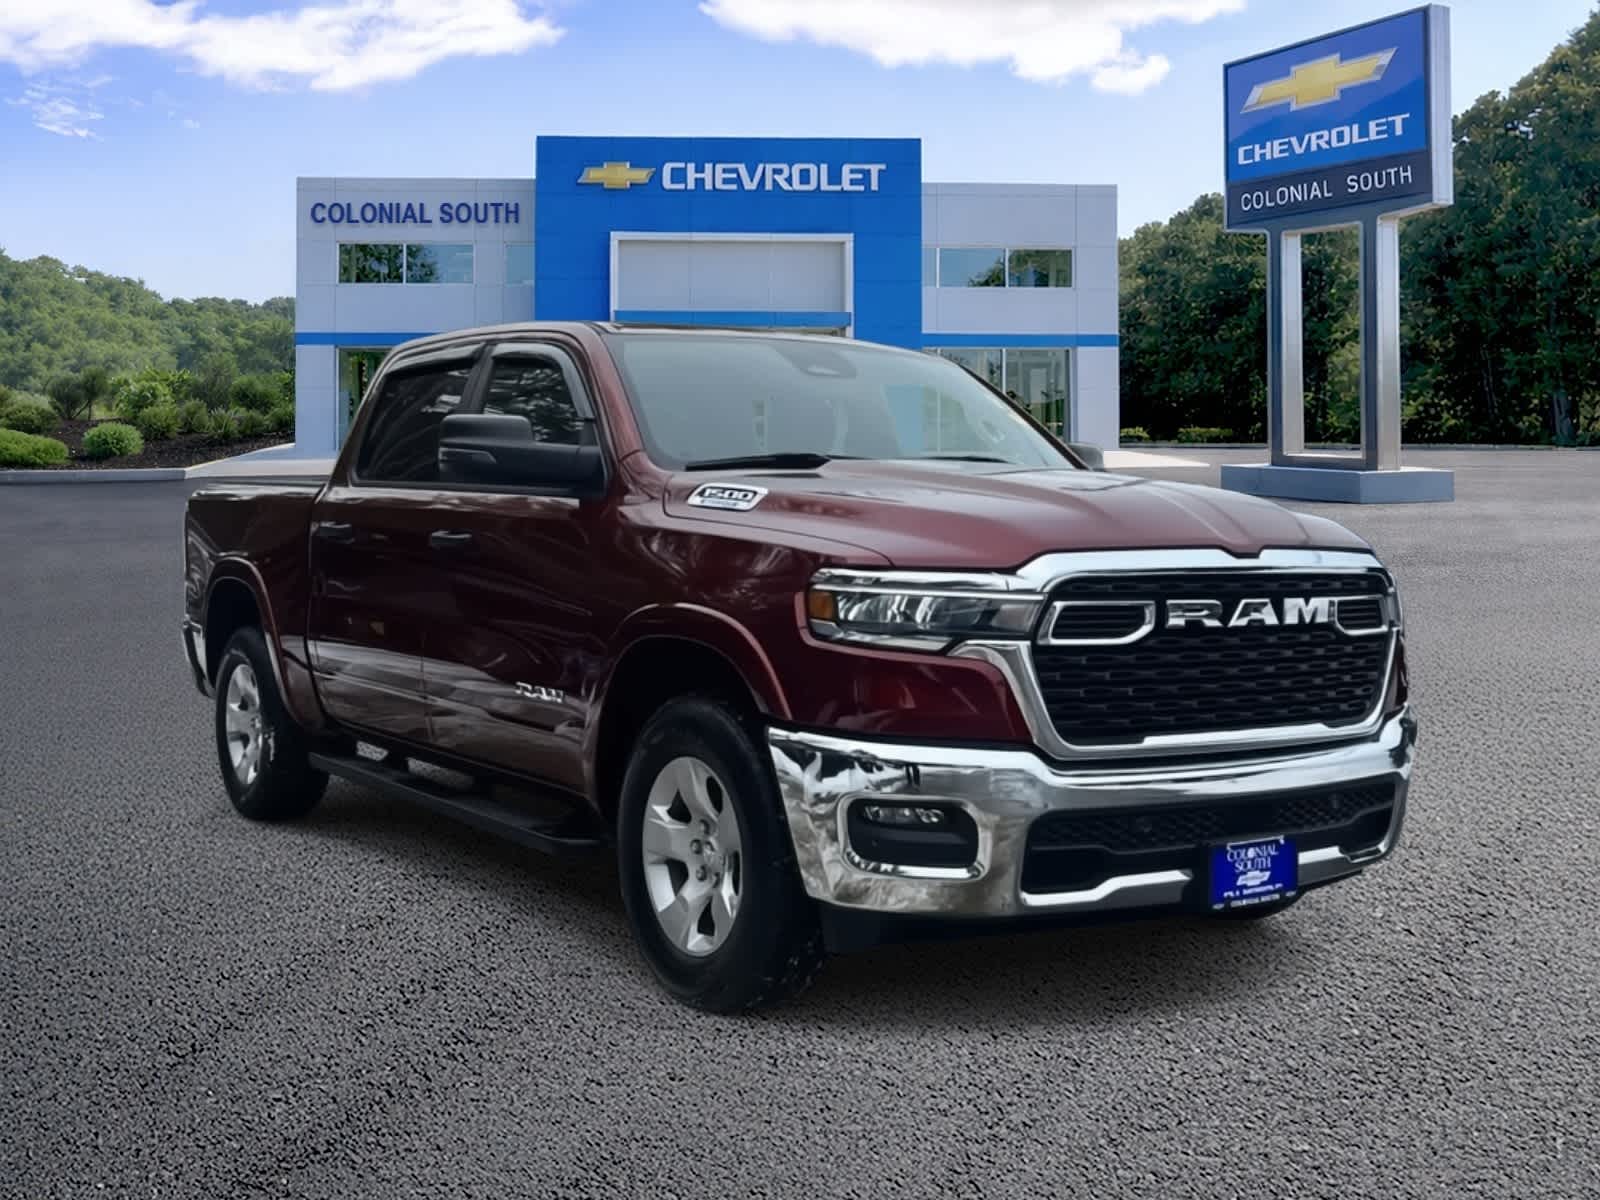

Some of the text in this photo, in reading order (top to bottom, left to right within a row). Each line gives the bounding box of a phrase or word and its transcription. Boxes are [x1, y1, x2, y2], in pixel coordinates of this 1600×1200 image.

[1237, 113, 1410, 165] CHEVROLET
[662, 162, 887, 192] CHEVROLET
[1240, 165, 1413, 211] COLONIAL SOUTH
[310, 202, 520, 224] COLONIAL SOUTH
[1165, 597, 1329, 628] RAM
[1227, 843, 1279, 862] COLONIAL
[1234, 856, 1271, 873] SOUTH
